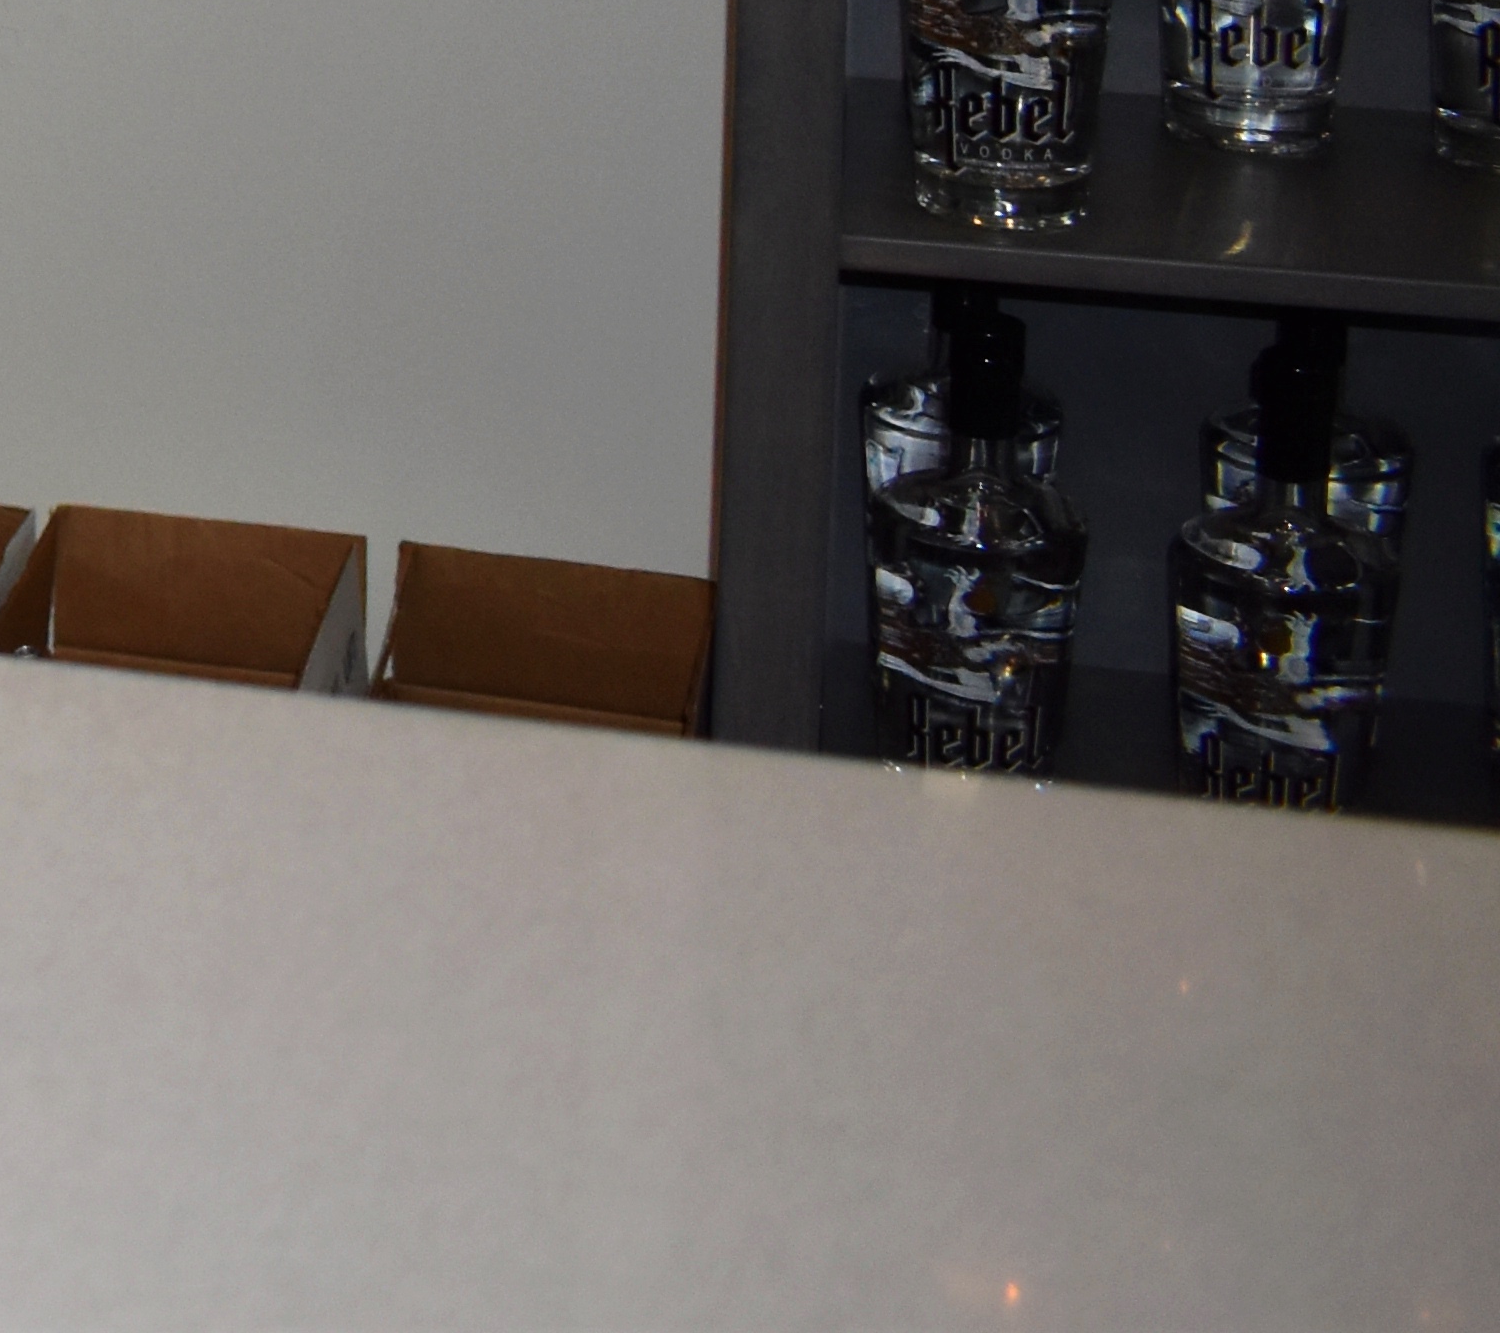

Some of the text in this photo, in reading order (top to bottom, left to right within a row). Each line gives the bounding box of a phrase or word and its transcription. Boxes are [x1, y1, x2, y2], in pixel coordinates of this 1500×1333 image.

[932, 60, 1075, 178] Rebel
[958, 141, 1055, 161] VODKA
[905, 694, 1044, 772] Rebel
